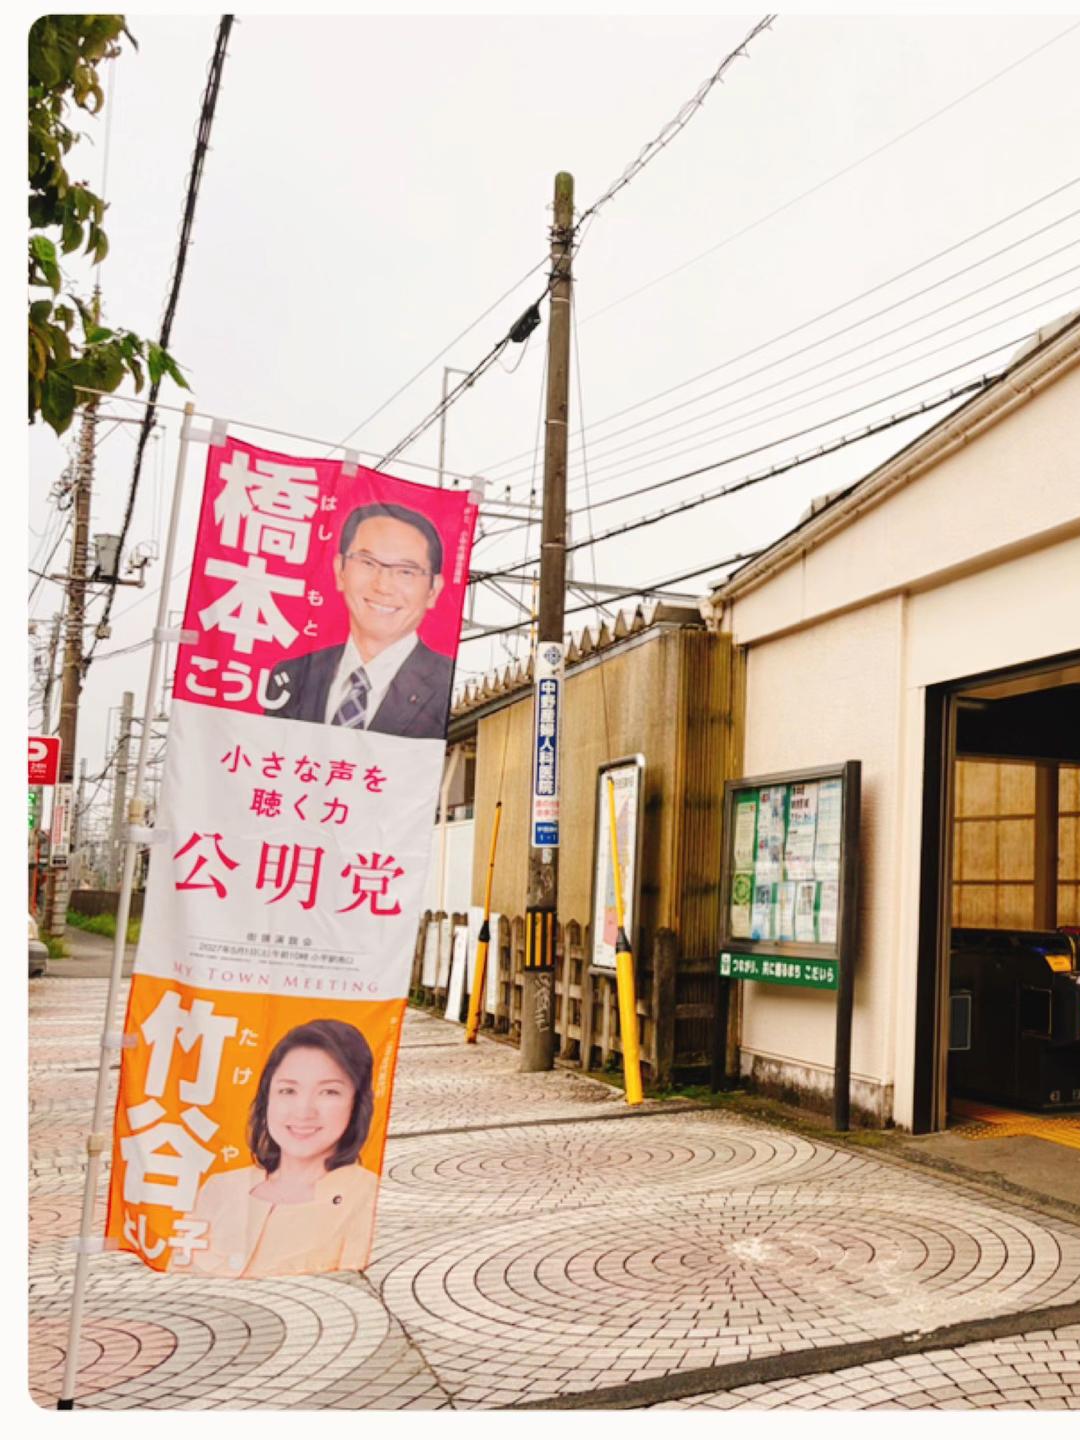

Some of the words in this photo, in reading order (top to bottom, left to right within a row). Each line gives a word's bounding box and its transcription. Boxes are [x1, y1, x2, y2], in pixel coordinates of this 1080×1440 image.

[199, 451, 320, 654] 橋本
[185, 655, 291, 710] こうじ
[221, 745, 388, 793] 小さな声を
[250, 788, 350, 825] 聴く力
[173, 832, 404, 916] 公明党
[173, 962, 193, 978] MY
[207, 968, 271, 985] TOWN
[284, 976, 379, 993] MEETING
[120, 990, 238, 1211] 竹谷
[123, 1210, 208, 1266] とし子
